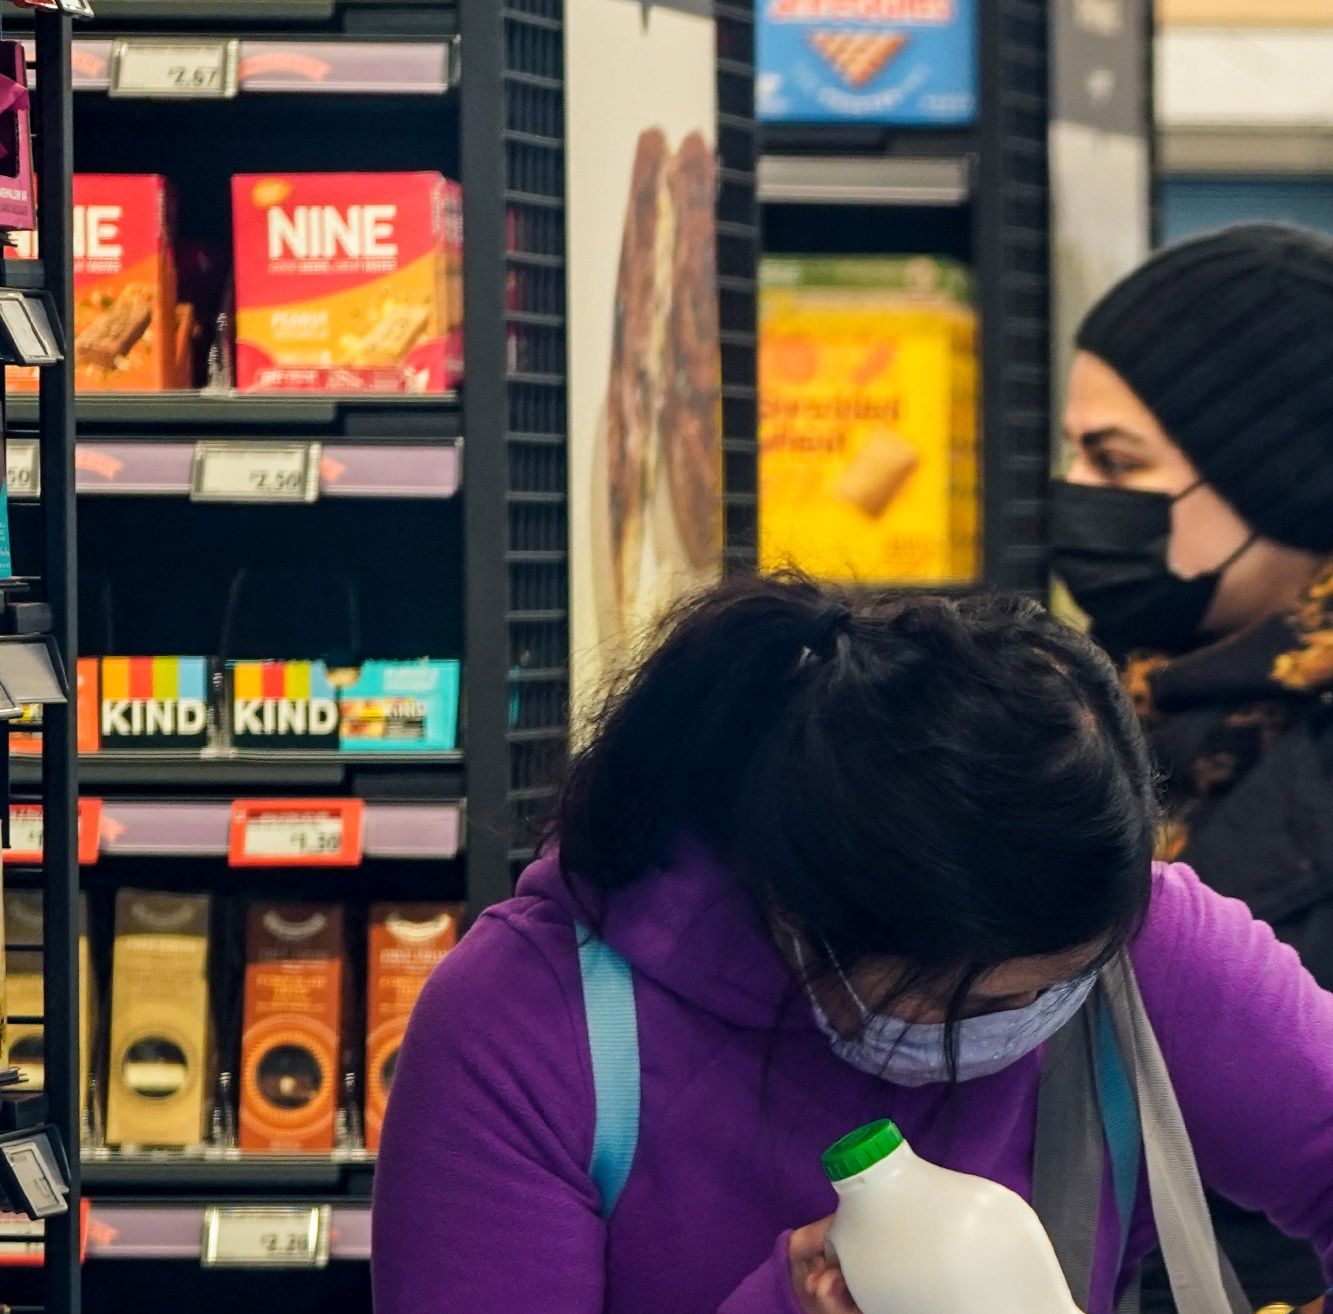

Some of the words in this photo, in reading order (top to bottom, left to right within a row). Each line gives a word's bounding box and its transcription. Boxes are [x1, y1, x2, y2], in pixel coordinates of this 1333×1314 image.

[268, 205, 397, 258] NINE
[102, 701, 207, 736] KIND
[233, 700, 339, 735] KIND
